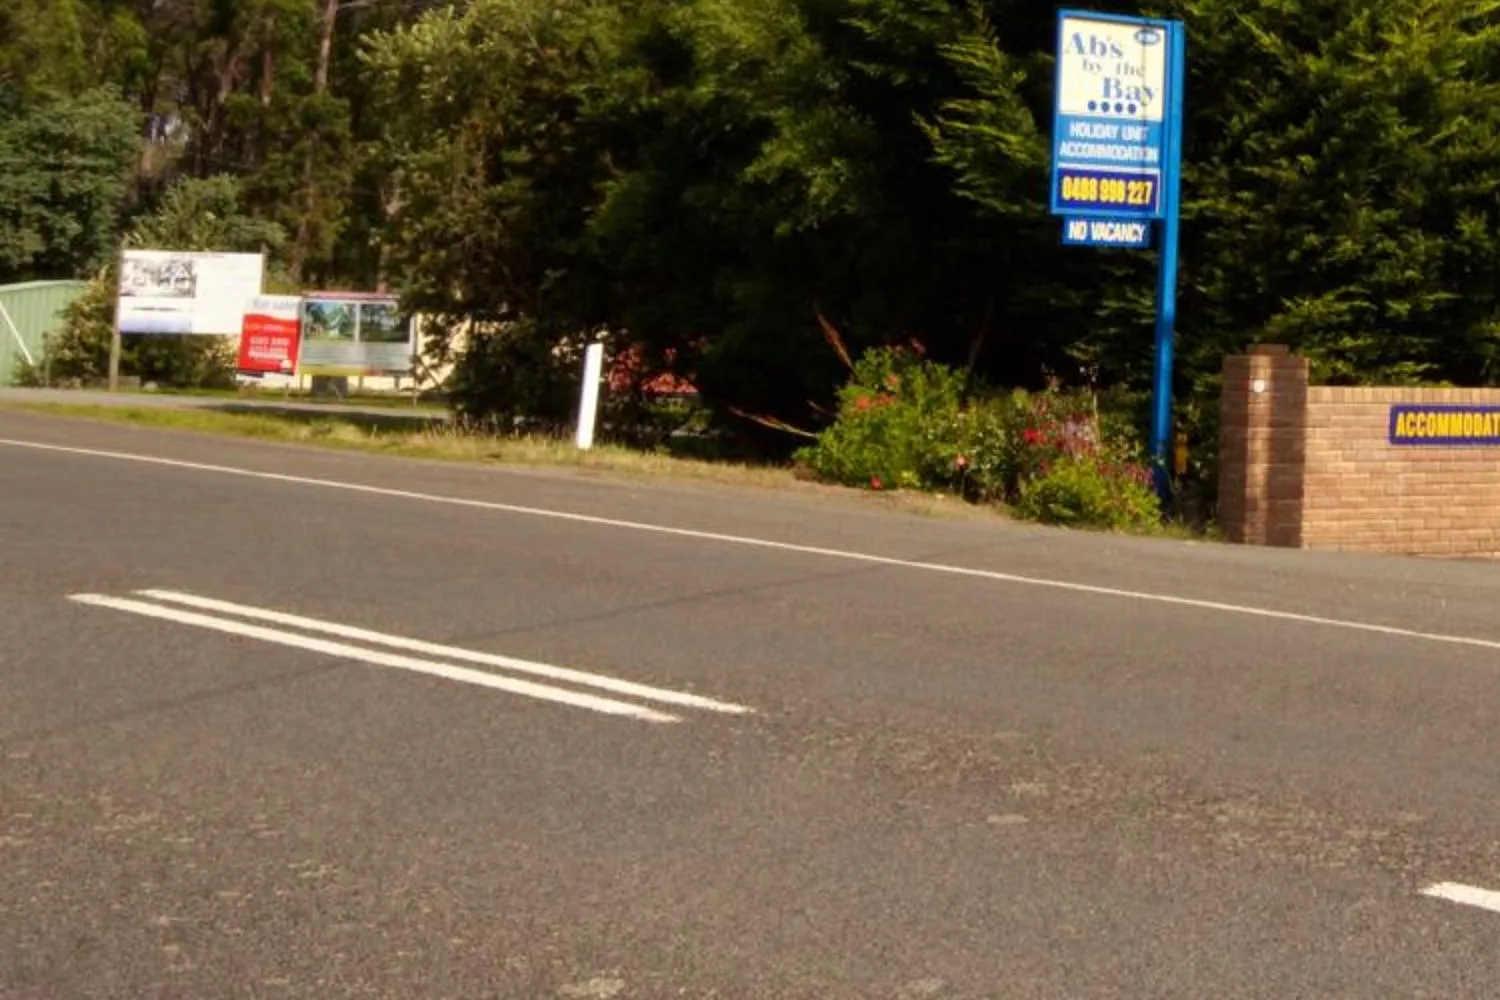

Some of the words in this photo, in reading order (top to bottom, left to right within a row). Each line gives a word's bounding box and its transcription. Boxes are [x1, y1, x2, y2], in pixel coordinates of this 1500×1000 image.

[1082, 59, 1103, 75] by
[1115, 62, 1147, 77] the
[1103, 76, 1159, 107] Bay
[1068, 220, 1087, 241] NO
[1091, 221, 1146, 243] VACANCY
